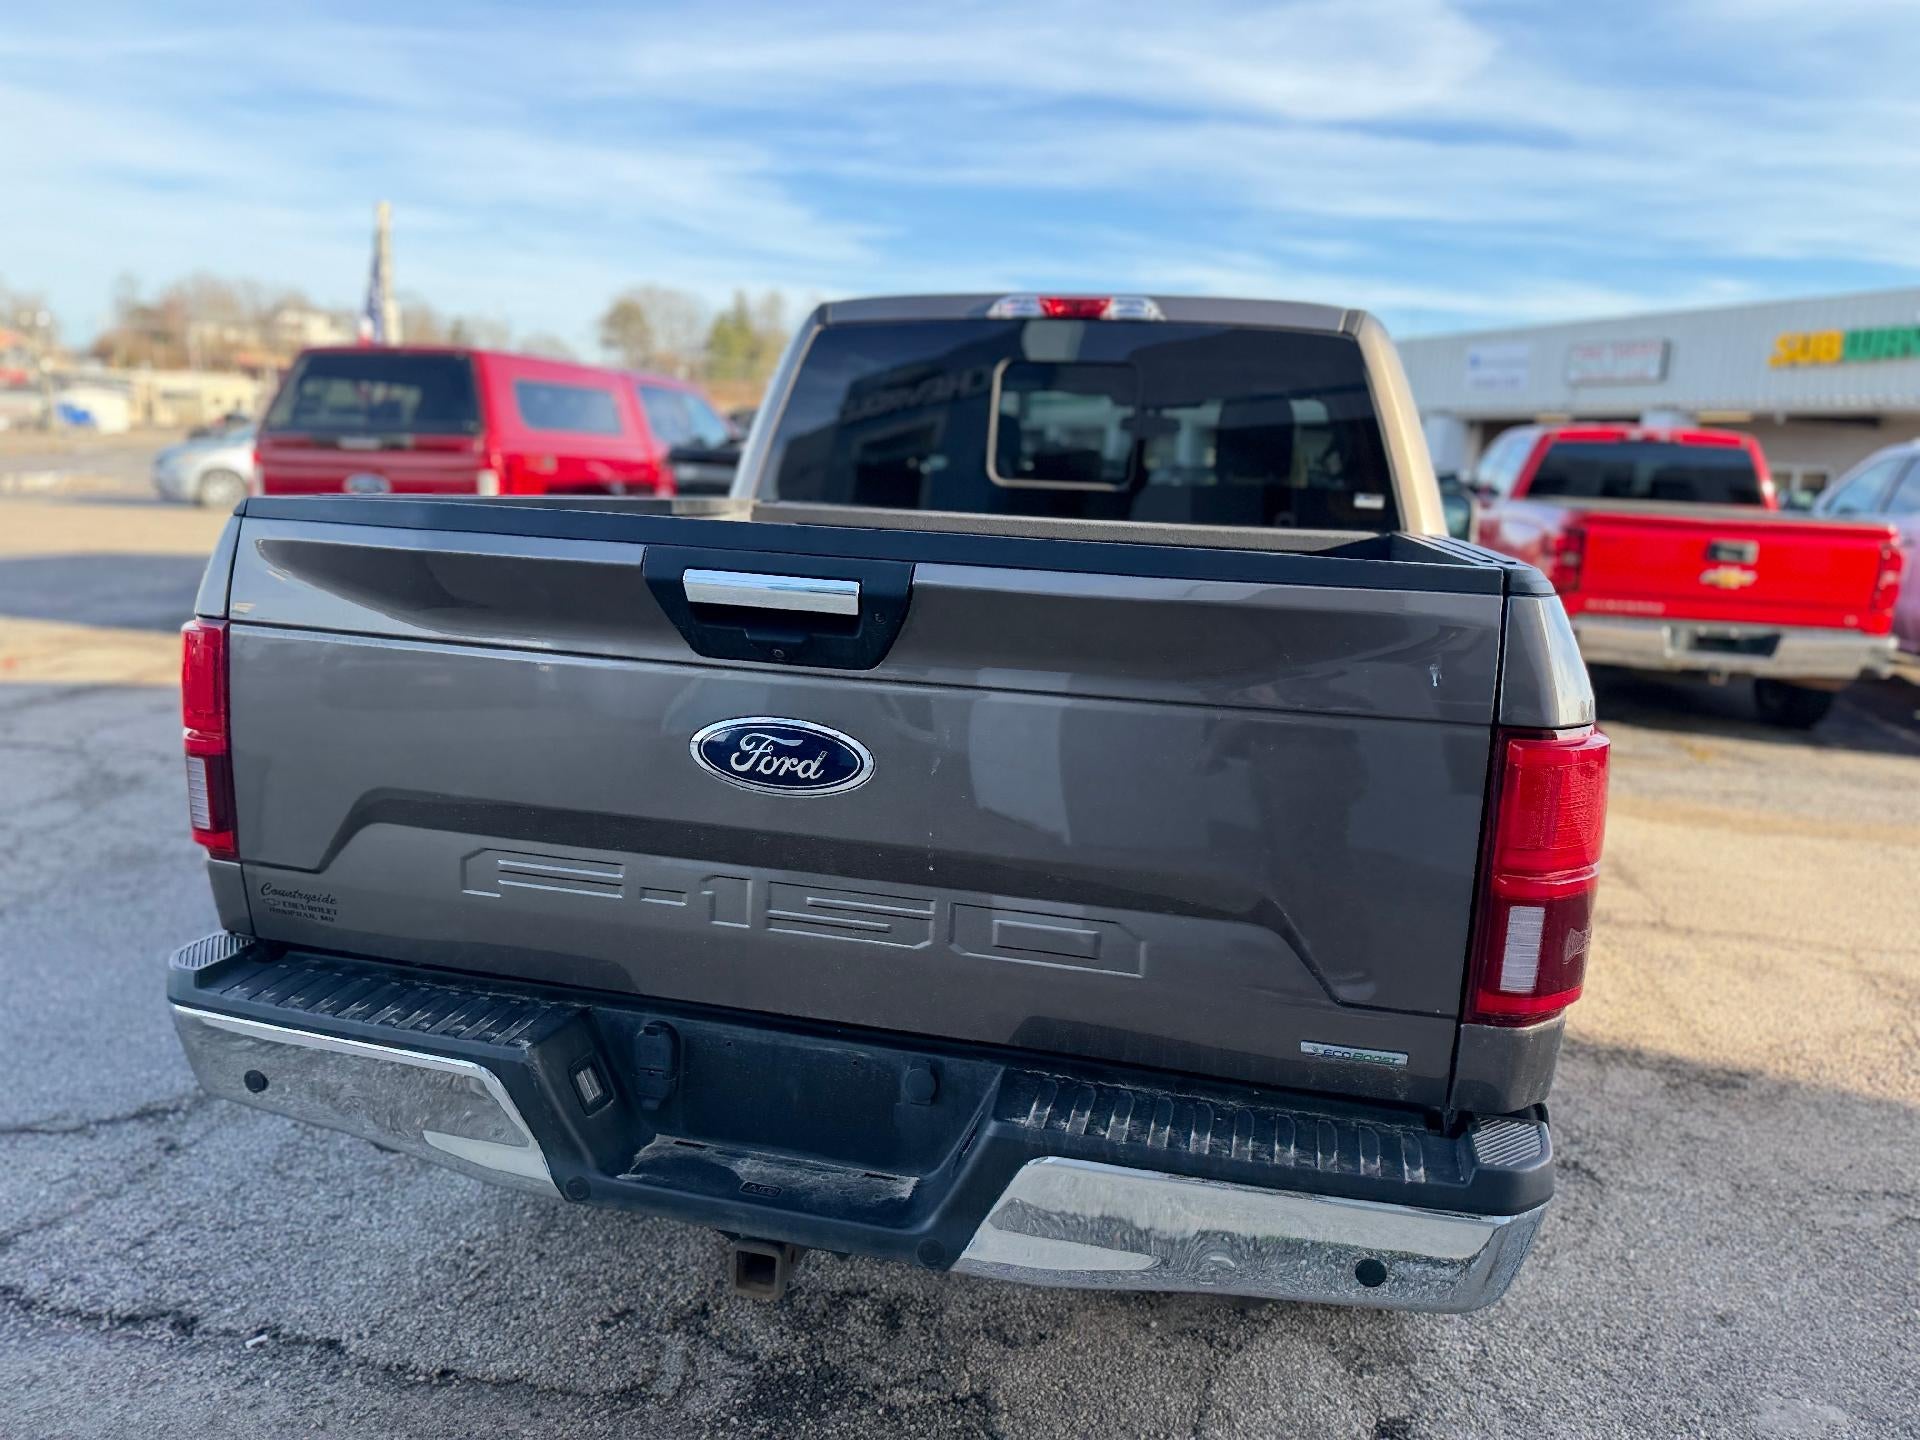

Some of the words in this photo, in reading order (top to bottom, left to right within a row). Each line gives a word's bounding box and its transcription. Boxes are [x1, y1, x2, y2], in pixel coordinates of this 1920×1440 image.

[730, 732, 828, 780] Ford
[260, 882, 336, 904] Countryside
[461, 847, 1146, 978] F-150
